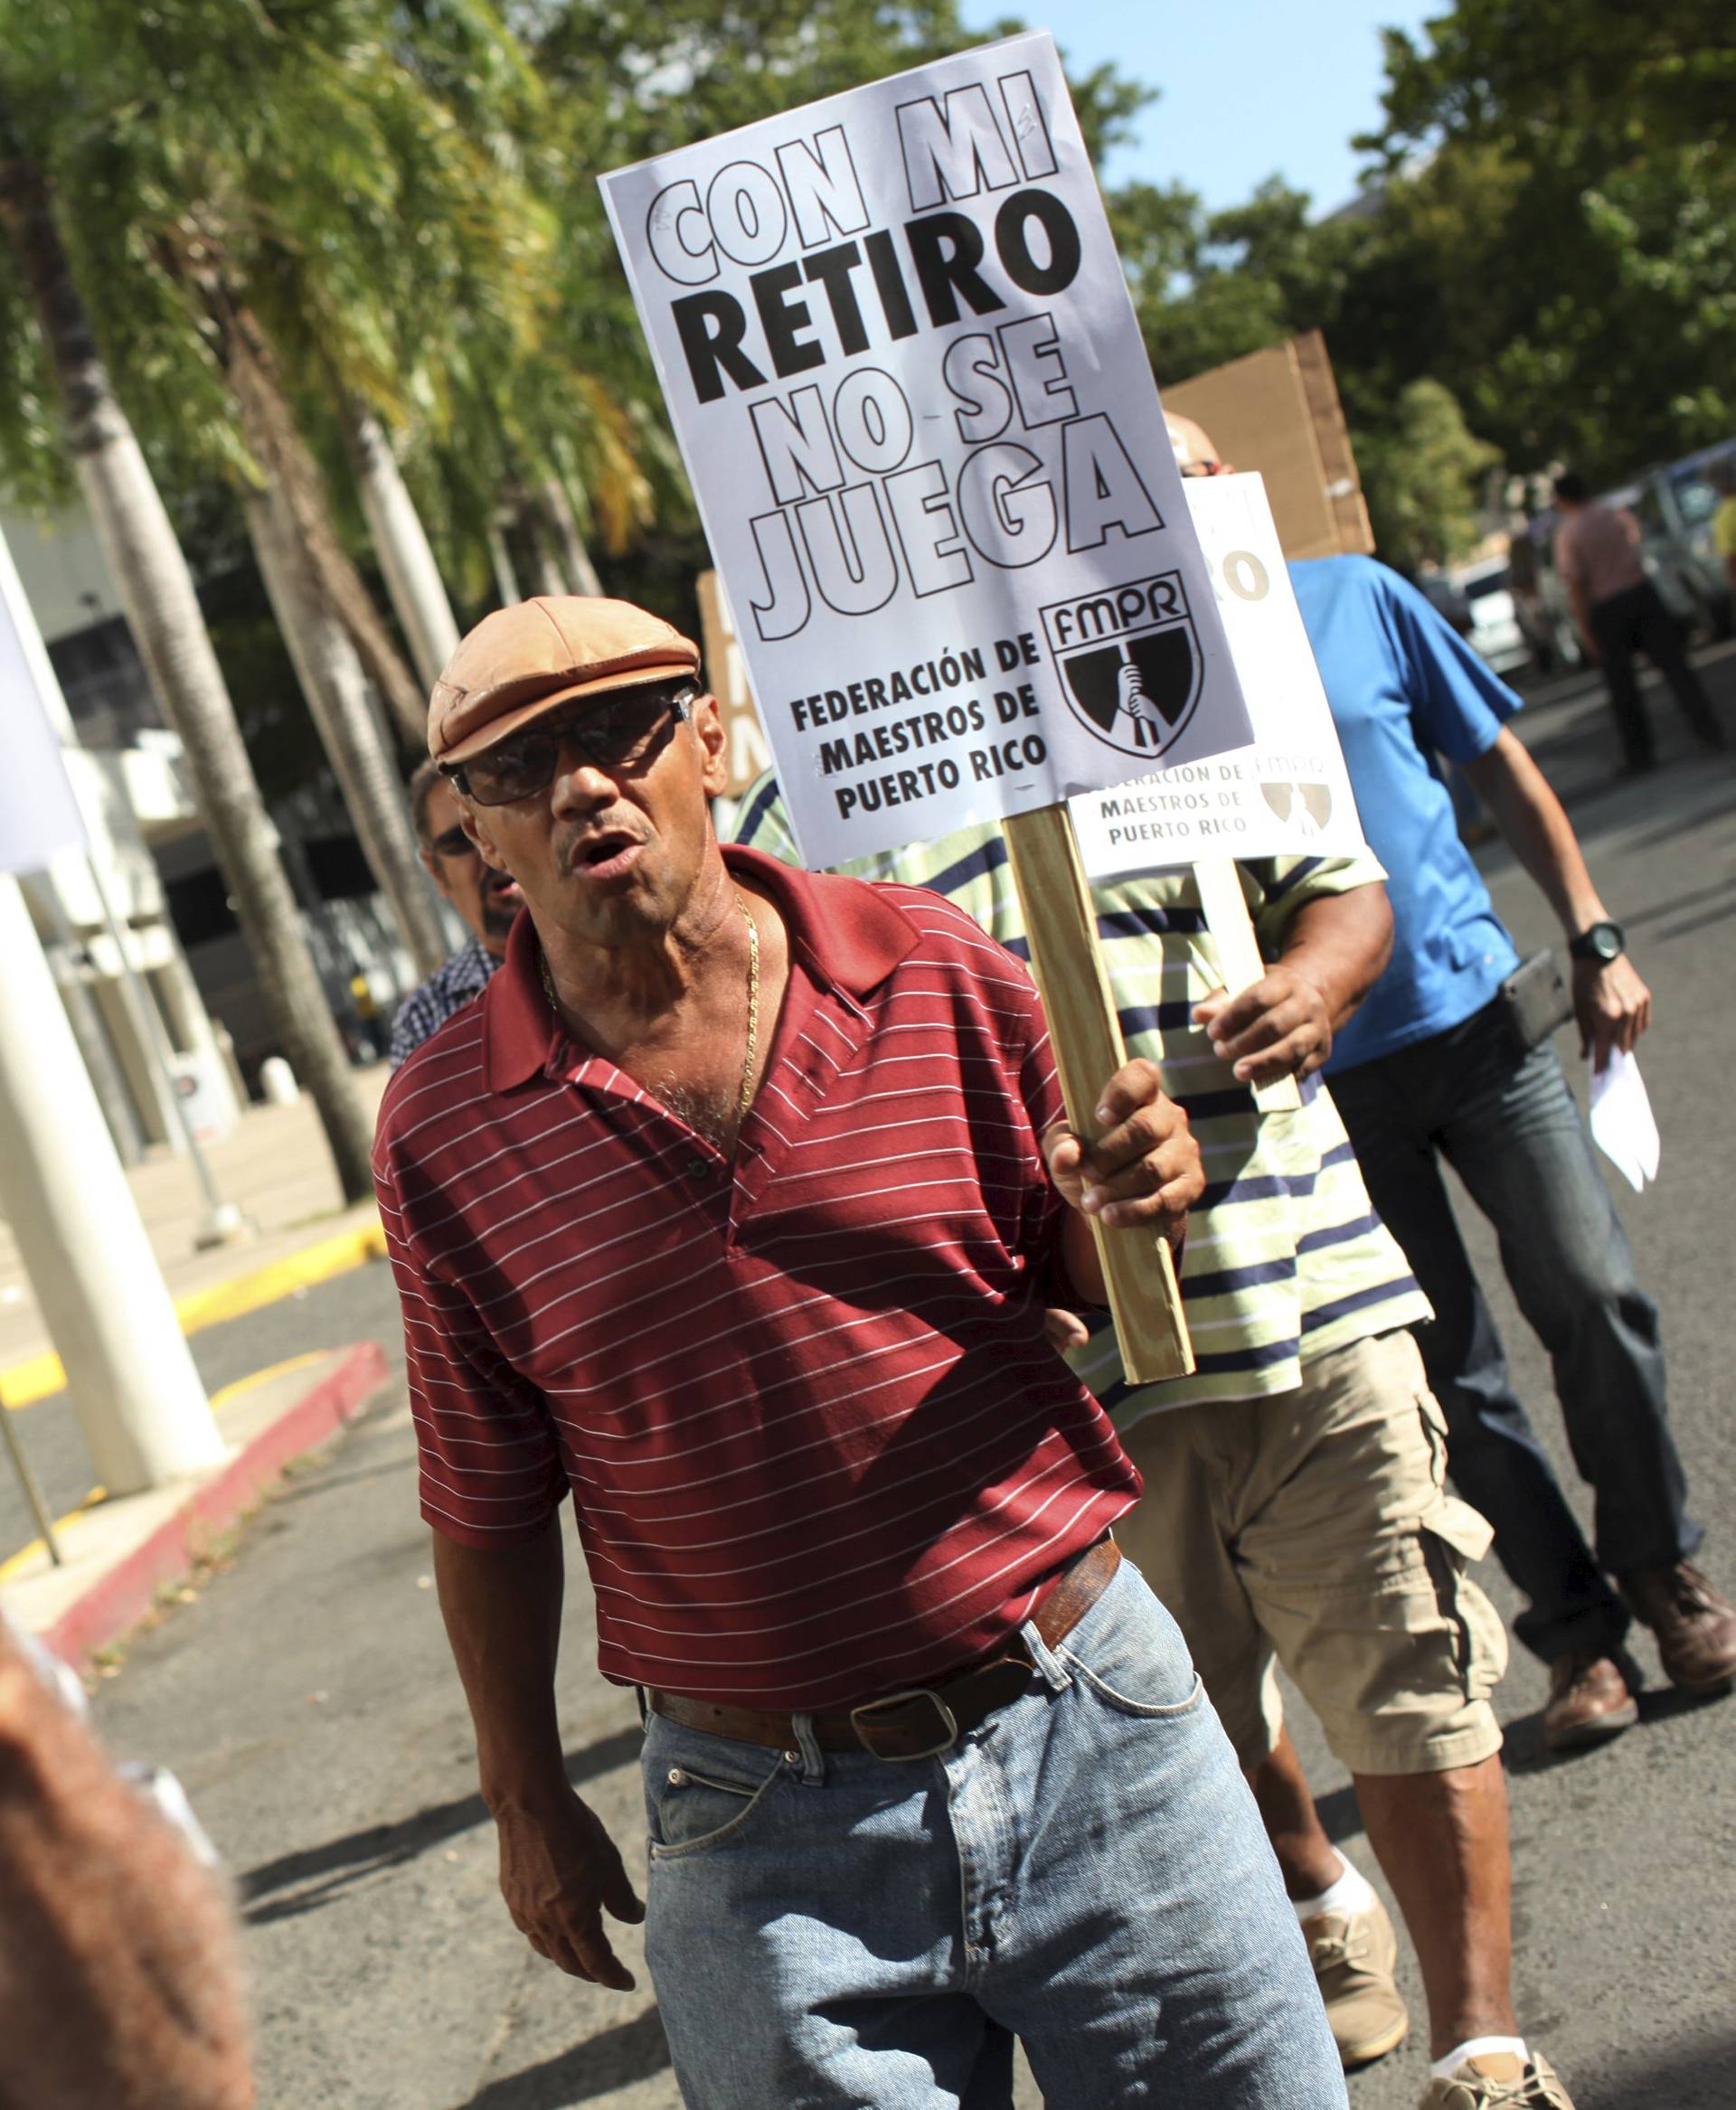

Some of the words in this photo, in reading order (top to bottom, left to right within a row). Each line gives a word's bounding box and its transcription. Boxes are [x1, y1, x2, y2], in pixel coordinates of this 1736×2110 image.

[646, 124, 871, 287] CON
[895, 70, 1060, 214] MI
[670, 188, 1083, 405] RETIRO
[748, 367, 913, 507] NO
[942, 313, 1080, 444] SE
[748, 411, 1165, 642] JUEGA
[1054, 579, 1181, 645] FMPR
[789, 646, 986, 732] FEDERACIÓN
[994, 632, 1042, 673] DE
[818, 700, 986, 776] MAESTROS
[994, 684, 1041, 723] DE
[1220, 764, 1244, 781] DE
[834, 758, 961, 820] PUERTO
[969, 734, 1048, 783] RICO
[1099, 792, 1210, 819] MAESTROS
[1218, 790, 1244, 806] DE
[1109, 821, 1191, 846] PUERTO
[1199, 816, 1248, 836] RICO
